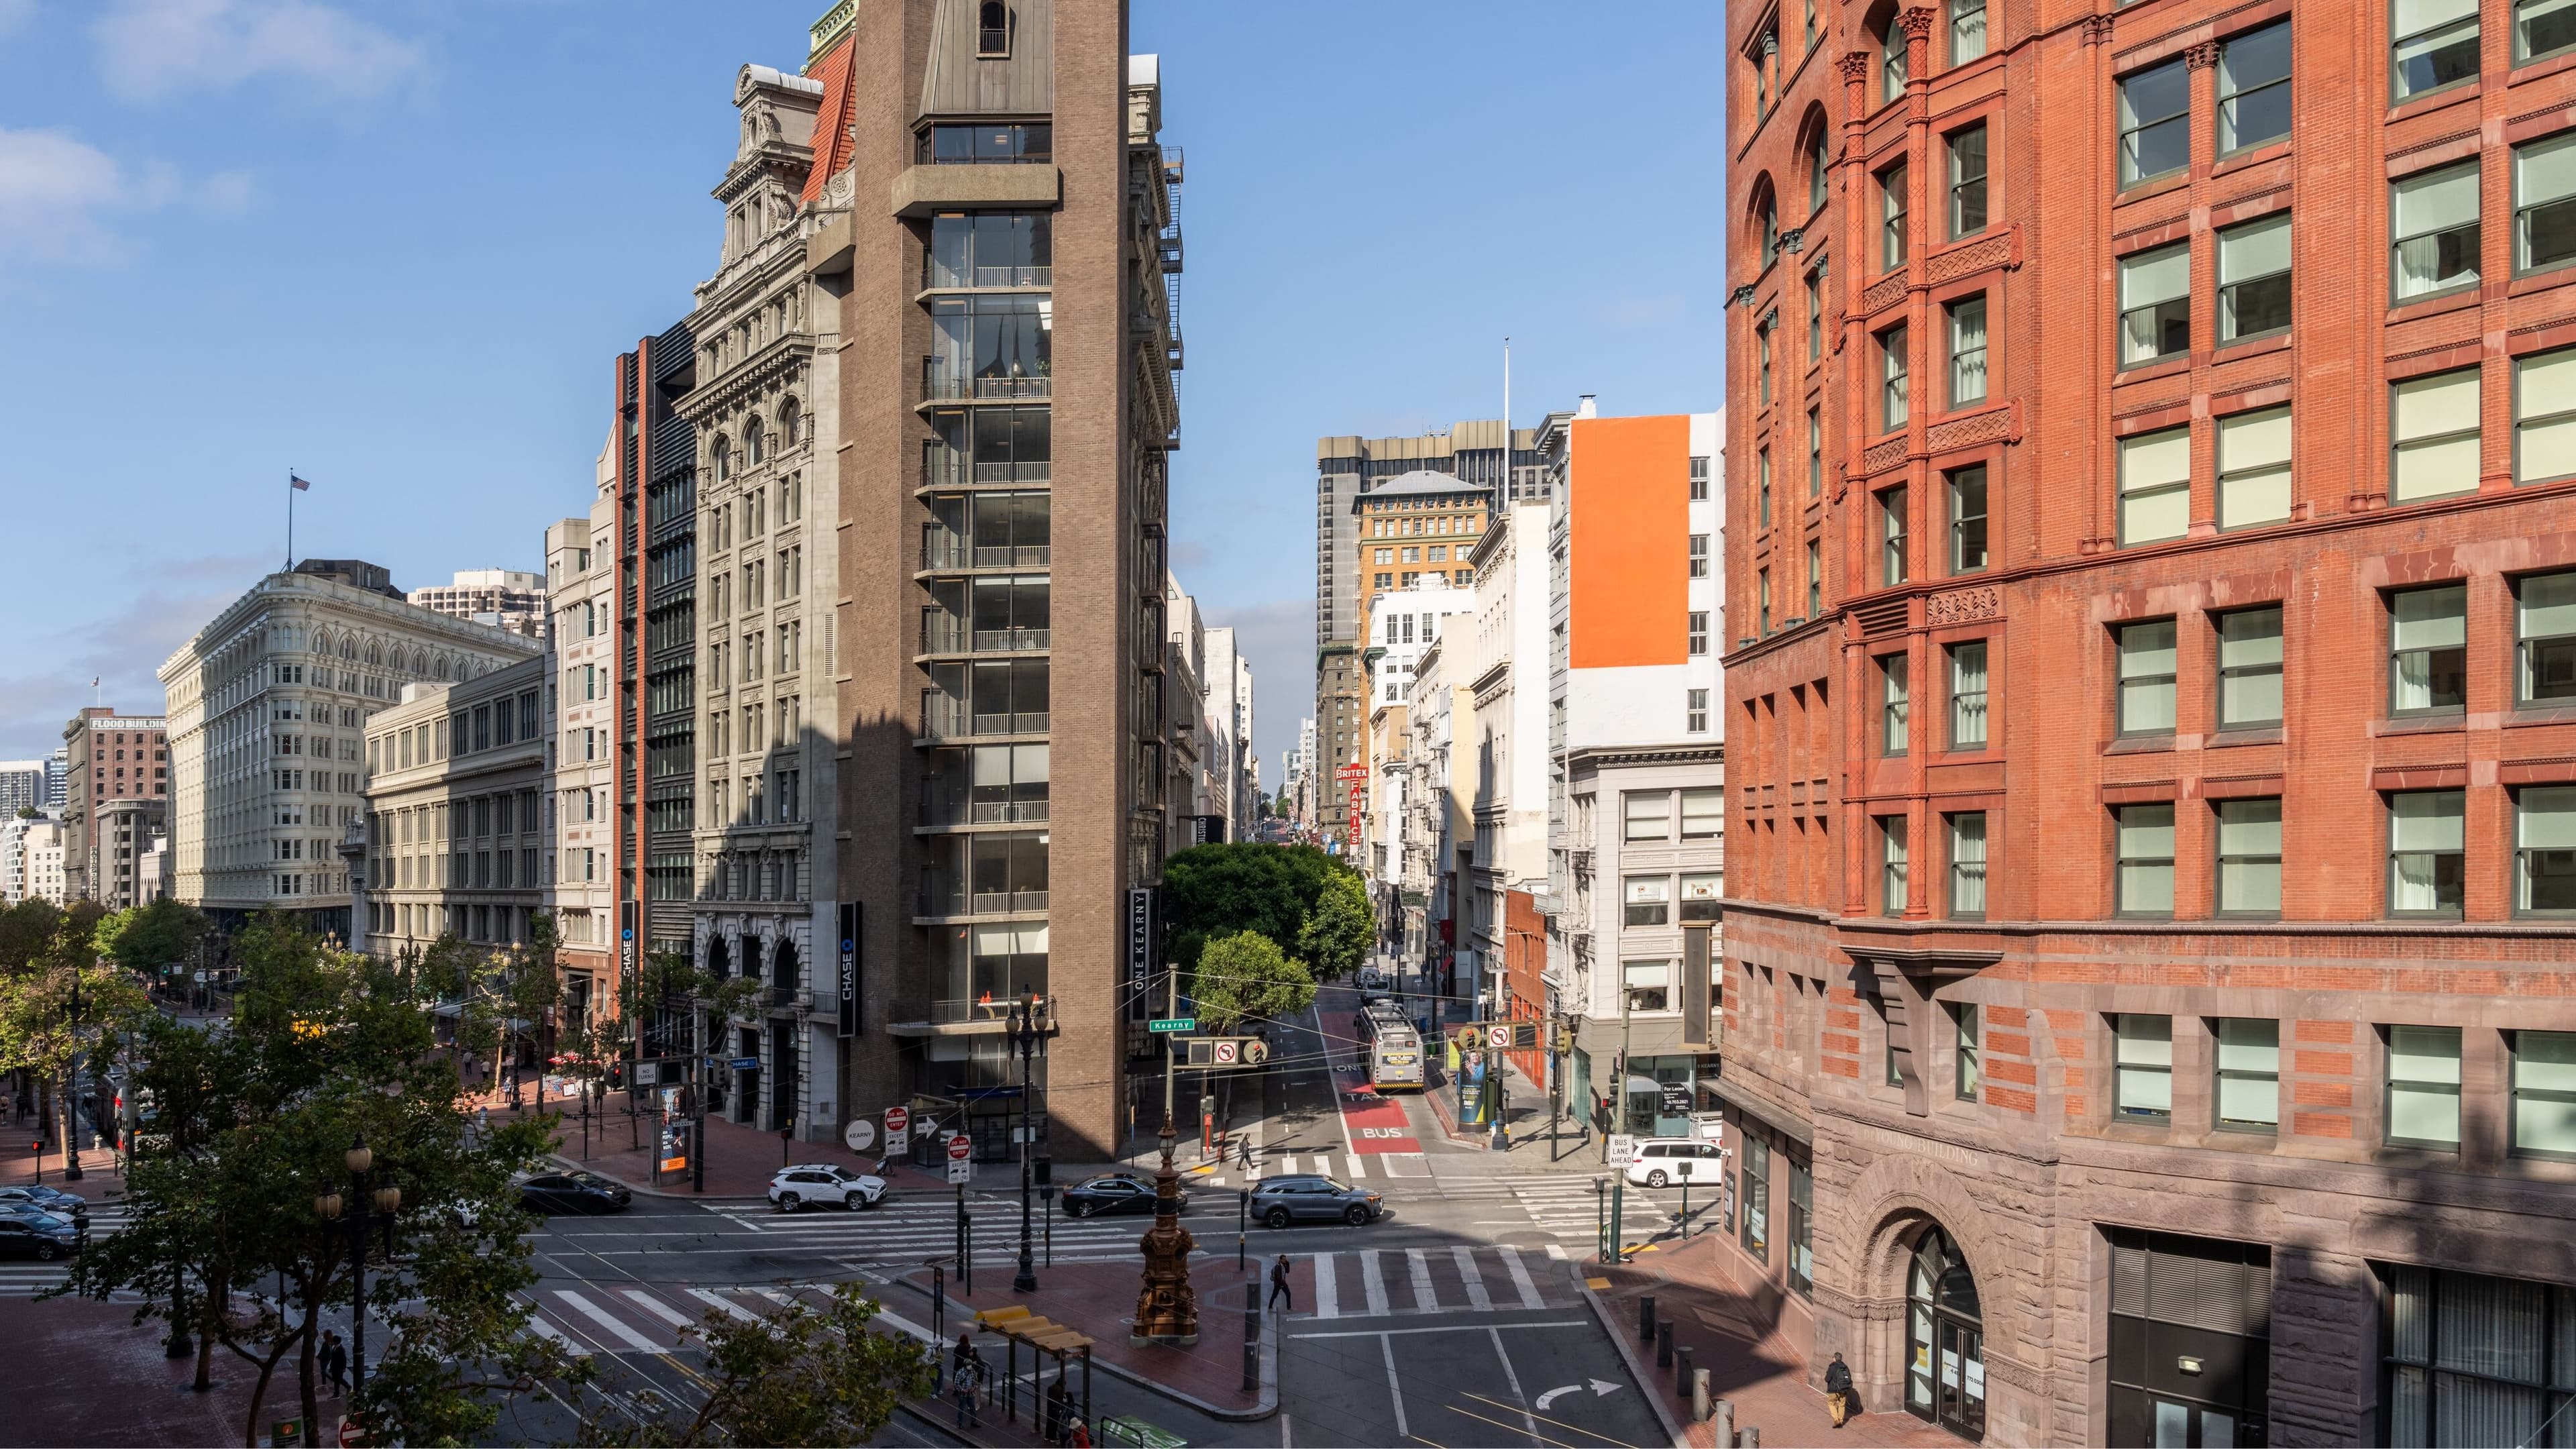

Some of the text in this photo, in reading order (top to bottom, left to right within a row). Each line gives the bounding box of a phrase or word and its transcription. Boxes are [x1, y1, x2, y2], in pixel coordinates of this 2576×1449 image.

[92, 720, 166, 728] FLOOD BUILDIN
[1336, 769, 1367, 779] BRITEX
[1135, 896, 1144, 990] ONE KEARNY
[843, 953, 852, 1000] CHASE
[1155, 1021, 1189, 1030] Kearny
[1362, 1128, 1403, 1138] BUS
[1917, 1140, 1978, 1166] BUILDING
[1611, 1156, 1632, 1165] AHEAD
